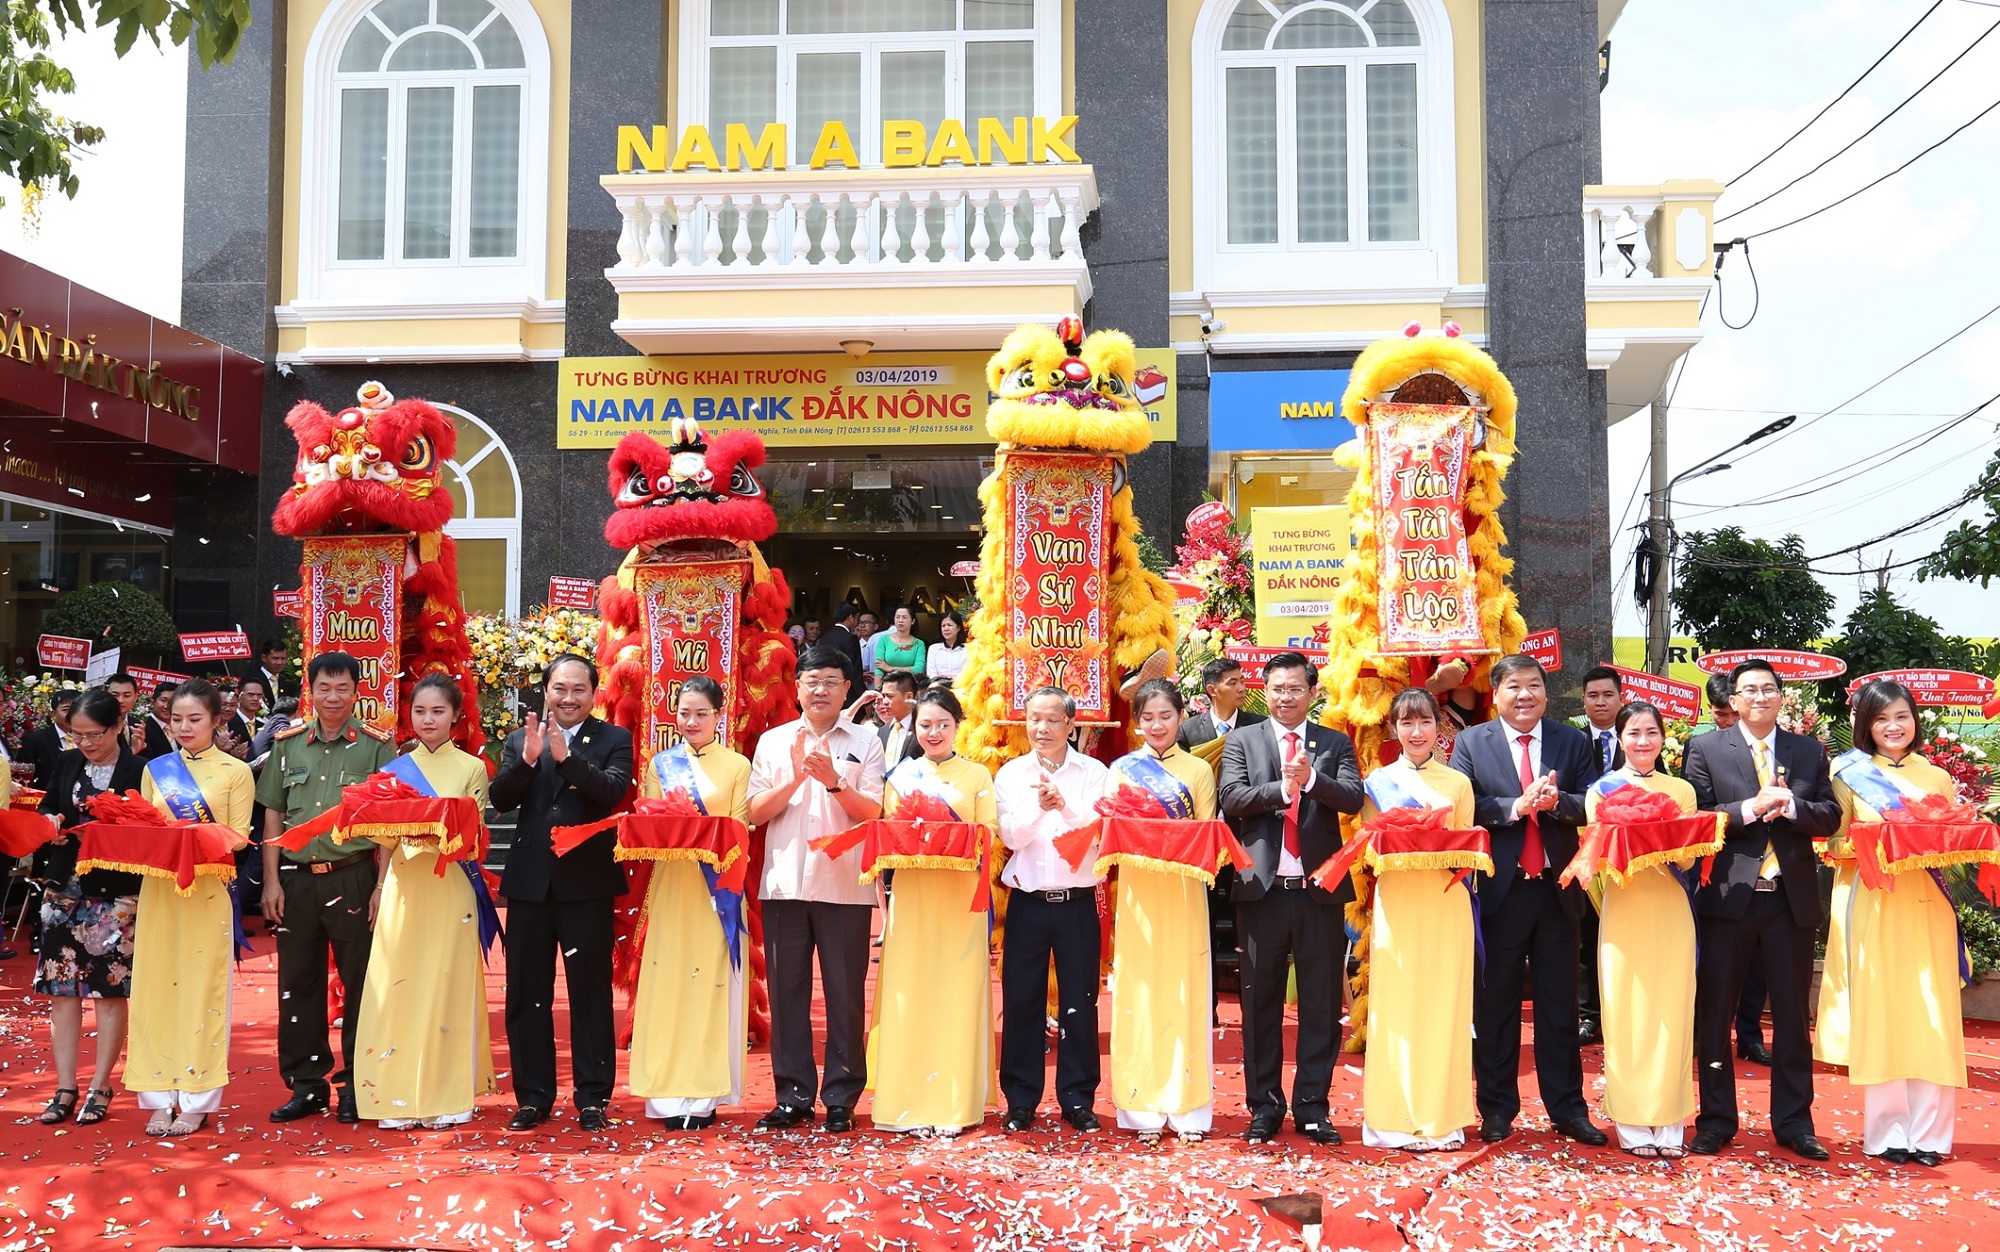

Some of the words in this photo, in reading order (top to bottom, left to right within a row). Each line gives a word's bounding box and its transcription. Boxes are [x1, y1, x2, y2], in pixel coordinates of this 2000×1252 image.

[618, 124, 787, 172] NAM
[810, 121, 860, 169] A
[883, 115, 1082, 167] BANK
[56, 334, 121, 395] ĐẮK
[126, 361, 200, 421] NÔNG
[574, 370, 628, 387] TƯNG
[634, 367, 688, 387] BỪNG
[693, 370, 739, 386] KHAI
[744, 368, 826, 385] TRƯƠNG
[855, 369, 938, 384] 03/04/2019
[571, 399, 654, 422] NAM
[661, 398, 686, 422] A
[694, 396, 793, 421] BANK
[801, 385, 869, 420] ĐẮK
[877, 389, 972, 420] NÔNG
[1281, 402, 1334, 418] NAM
[568, 429, 576, 437] Số
[782, 427, 798, 435] Tỉnh
[815, 427, 833, 436] Nông
[848, 426, 870, 434] 02613
[871, 426, 886, 434] 553
[920, 425, 943, 433] 02613
[1397, 463, 1450, 499] Tấn
[1272, 530, 1301, 539] TƯNG
[1302, 527, 1331, 538] BỪNG
[1401, 507, 1449, 540] Tài
[1031, 532, 1085, 571] Vạn
[1268, 544, 1292, 553] KHAI
[1294, 541, 1336, 552] TRƯƠNG
[1259, 560, 1293, 571] NAM
[1295, 560, 1305, 569] A
[1308, 558, 1345, 569] BANK
[1401, 545, 1457, 581] Tấn
[1267, 574, 1297, 590] ĐẮK
[1299, 573, 1341, 588] NÔNG
[1039, 573, 1075, 613] Sự
[1280, 605, 1329, 614] 03/04/2019
[1403, 592, 1457, 628] Lộc
[327, 610, 378, 641] Mua
[1030, 617, 1083, 649] Như
[1542, 635, 1555, 648] AN
[673, 639, 708, 672] Mã
[1229, 652, 1249, 662] NAM
[1250, 653, 1257, 662] A
[1621, 674, 1627, 683] A
[1628, 676, 1649, 690] BANK
[1917, 691, 1944, 702] Khai
